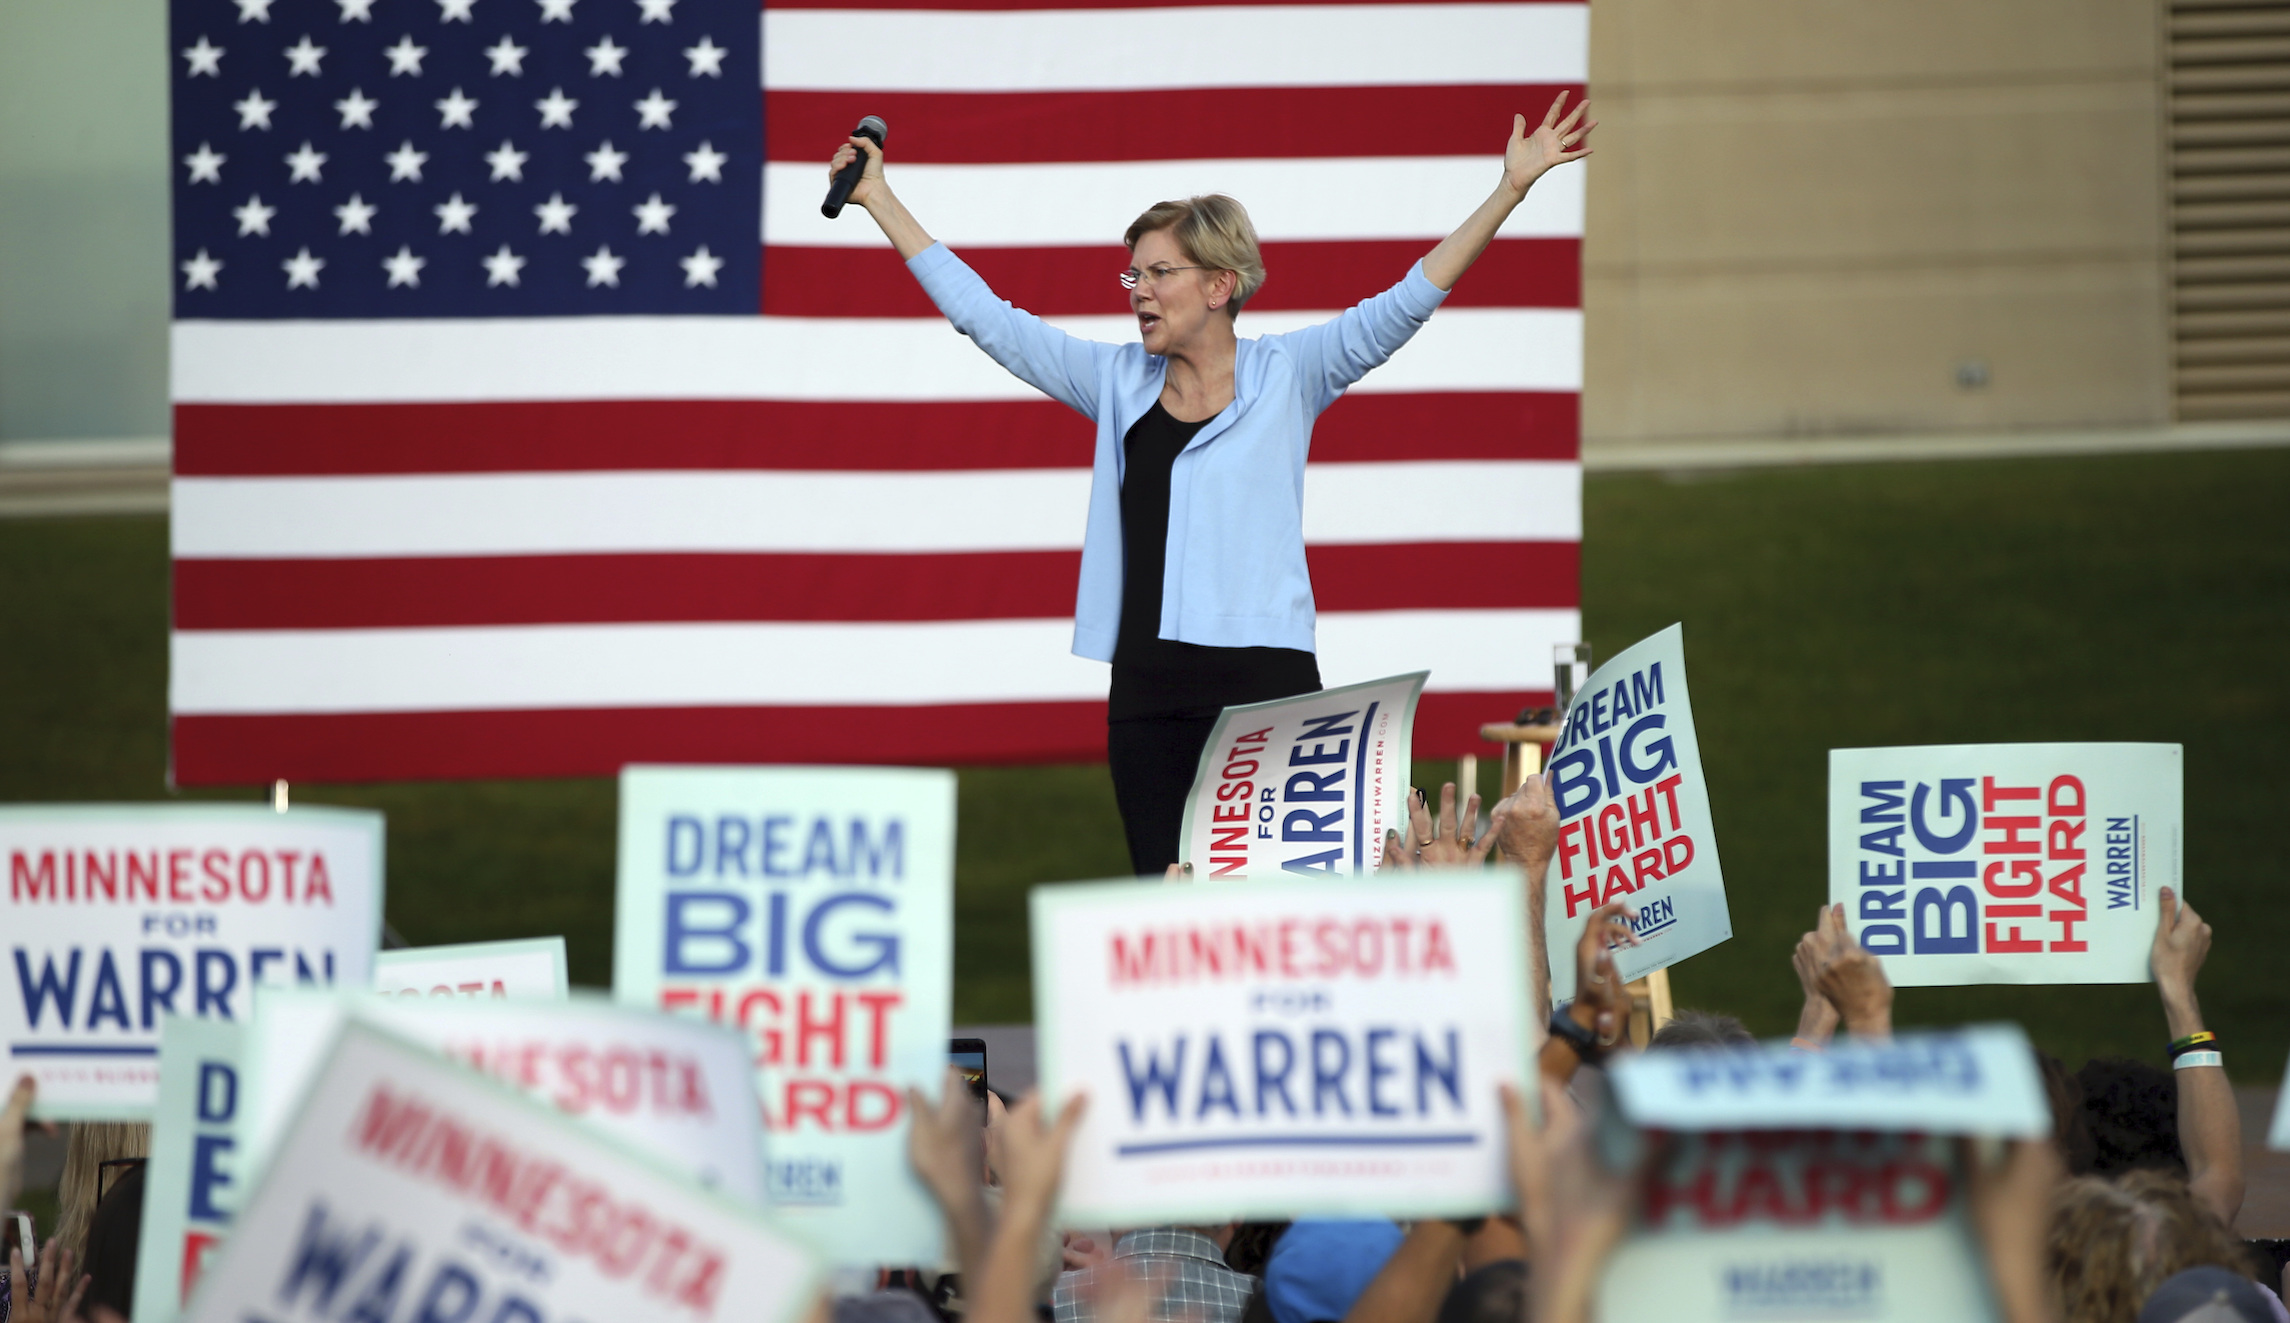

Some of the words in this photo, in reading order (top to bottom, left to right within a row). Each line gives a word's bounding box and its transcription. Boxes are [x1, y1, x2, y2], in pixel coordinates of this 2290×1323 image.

[1209, 726, 1275, 882] NNESOTA
[1258, 786, 1277, 839] FOR
[1281, 709, 1361, 881] ARREN
[1373, 711, 1390, 874] LIZABETHWARREN.COM
[1550, 713, 1679, 820] BIG
[664, 814, 906, 880] DREAM
[1557, 772, 1684, 880] FIGHT
[1860, 780, 1907, 955] DREAM
[1911, 778, 1979, 955] BIG
[1983, 776, 2044, 953] FIGHT
[2047, 774, 2088, 952] HARD
[2107, 817, 2131, 909] WARREN
[9, 849, 335, 907] MINNESOTA
[1563, 835, 1695, 919] HARD
[142, 913, 219, 937] FOR
[661, 890, 904, 979] BIG
[1108, 917, 1456, 990] MINNESOTA
[661, 987, 905, 1069] GHT
[1249, 989, 1332, 1019] FOR
[760, 1079, 906, 1134] RD
[1117, 1026, 1466, 1127] WARREN
[350, 1078, 730, 1319] MINNESOTA
[1646, 1162, 1951, 1228] HARD
